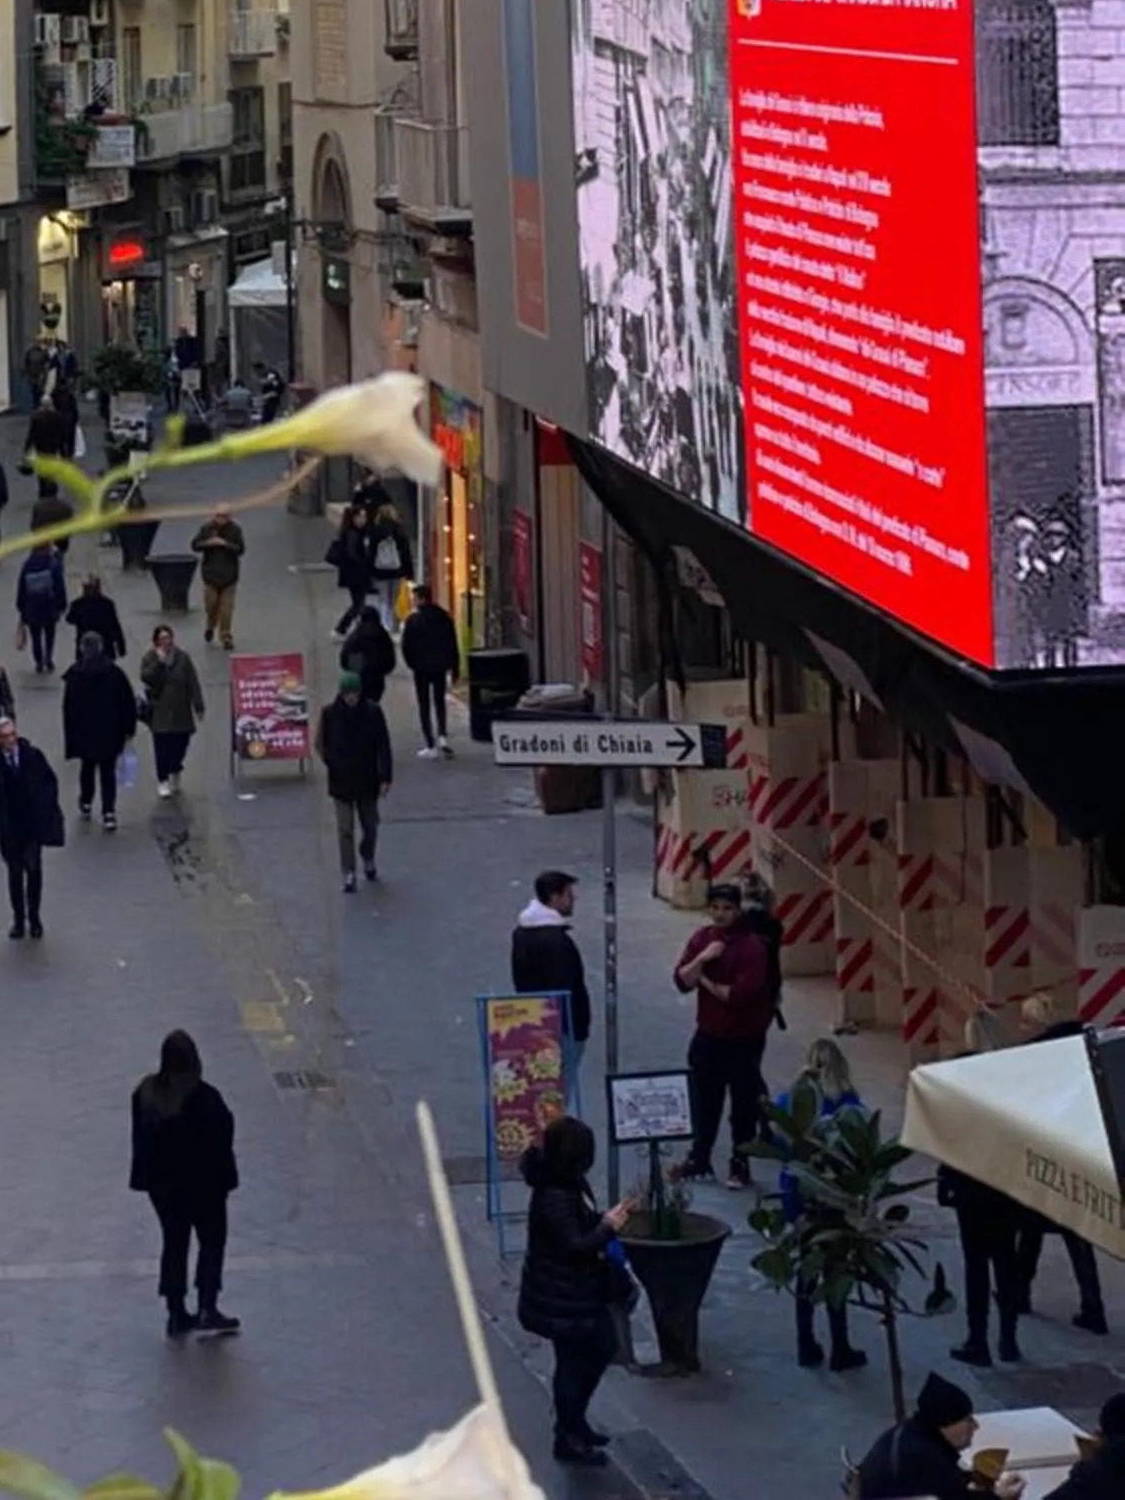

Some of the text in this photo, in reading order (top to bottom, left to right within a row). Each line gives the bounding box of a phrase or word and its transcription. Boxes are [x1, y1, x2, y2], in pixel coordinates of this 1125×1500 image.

[498, 733, 654, 755] Gradoni di Chiaia
[1024, 1145, 1070, 1201] PIZZA
[1070, 1171, 1084, 1206] E
